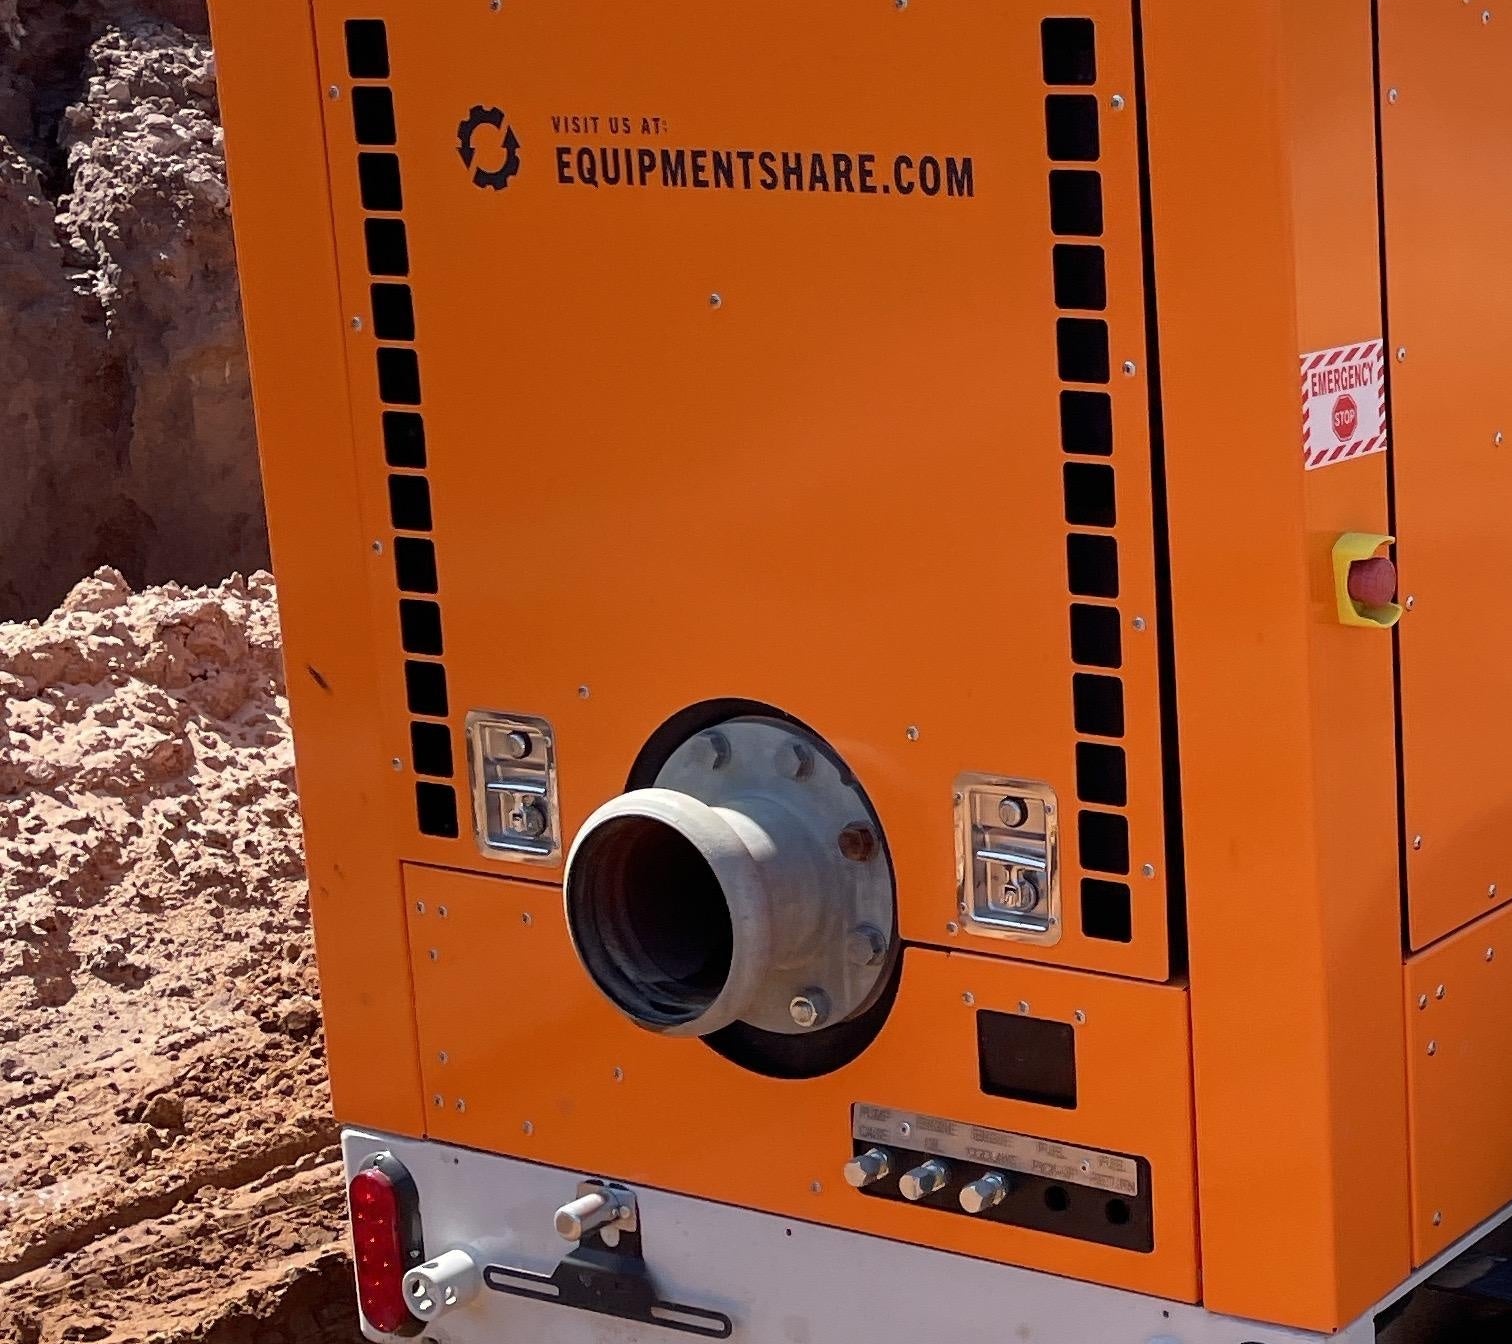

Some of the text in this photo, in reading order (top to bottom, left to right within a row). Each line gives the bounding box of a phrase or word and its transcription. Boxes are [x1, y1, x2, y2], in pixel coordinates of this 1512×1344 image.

[550, 115, 600, 134] VISIT
[607, 115, 631, 134] US
[555, 145, 976, 198] EQUIPMENTSHARE.COM
[1311, 362, 1374, 397] EMERGENCY
[1335, 410, 1355, 427] STOP
